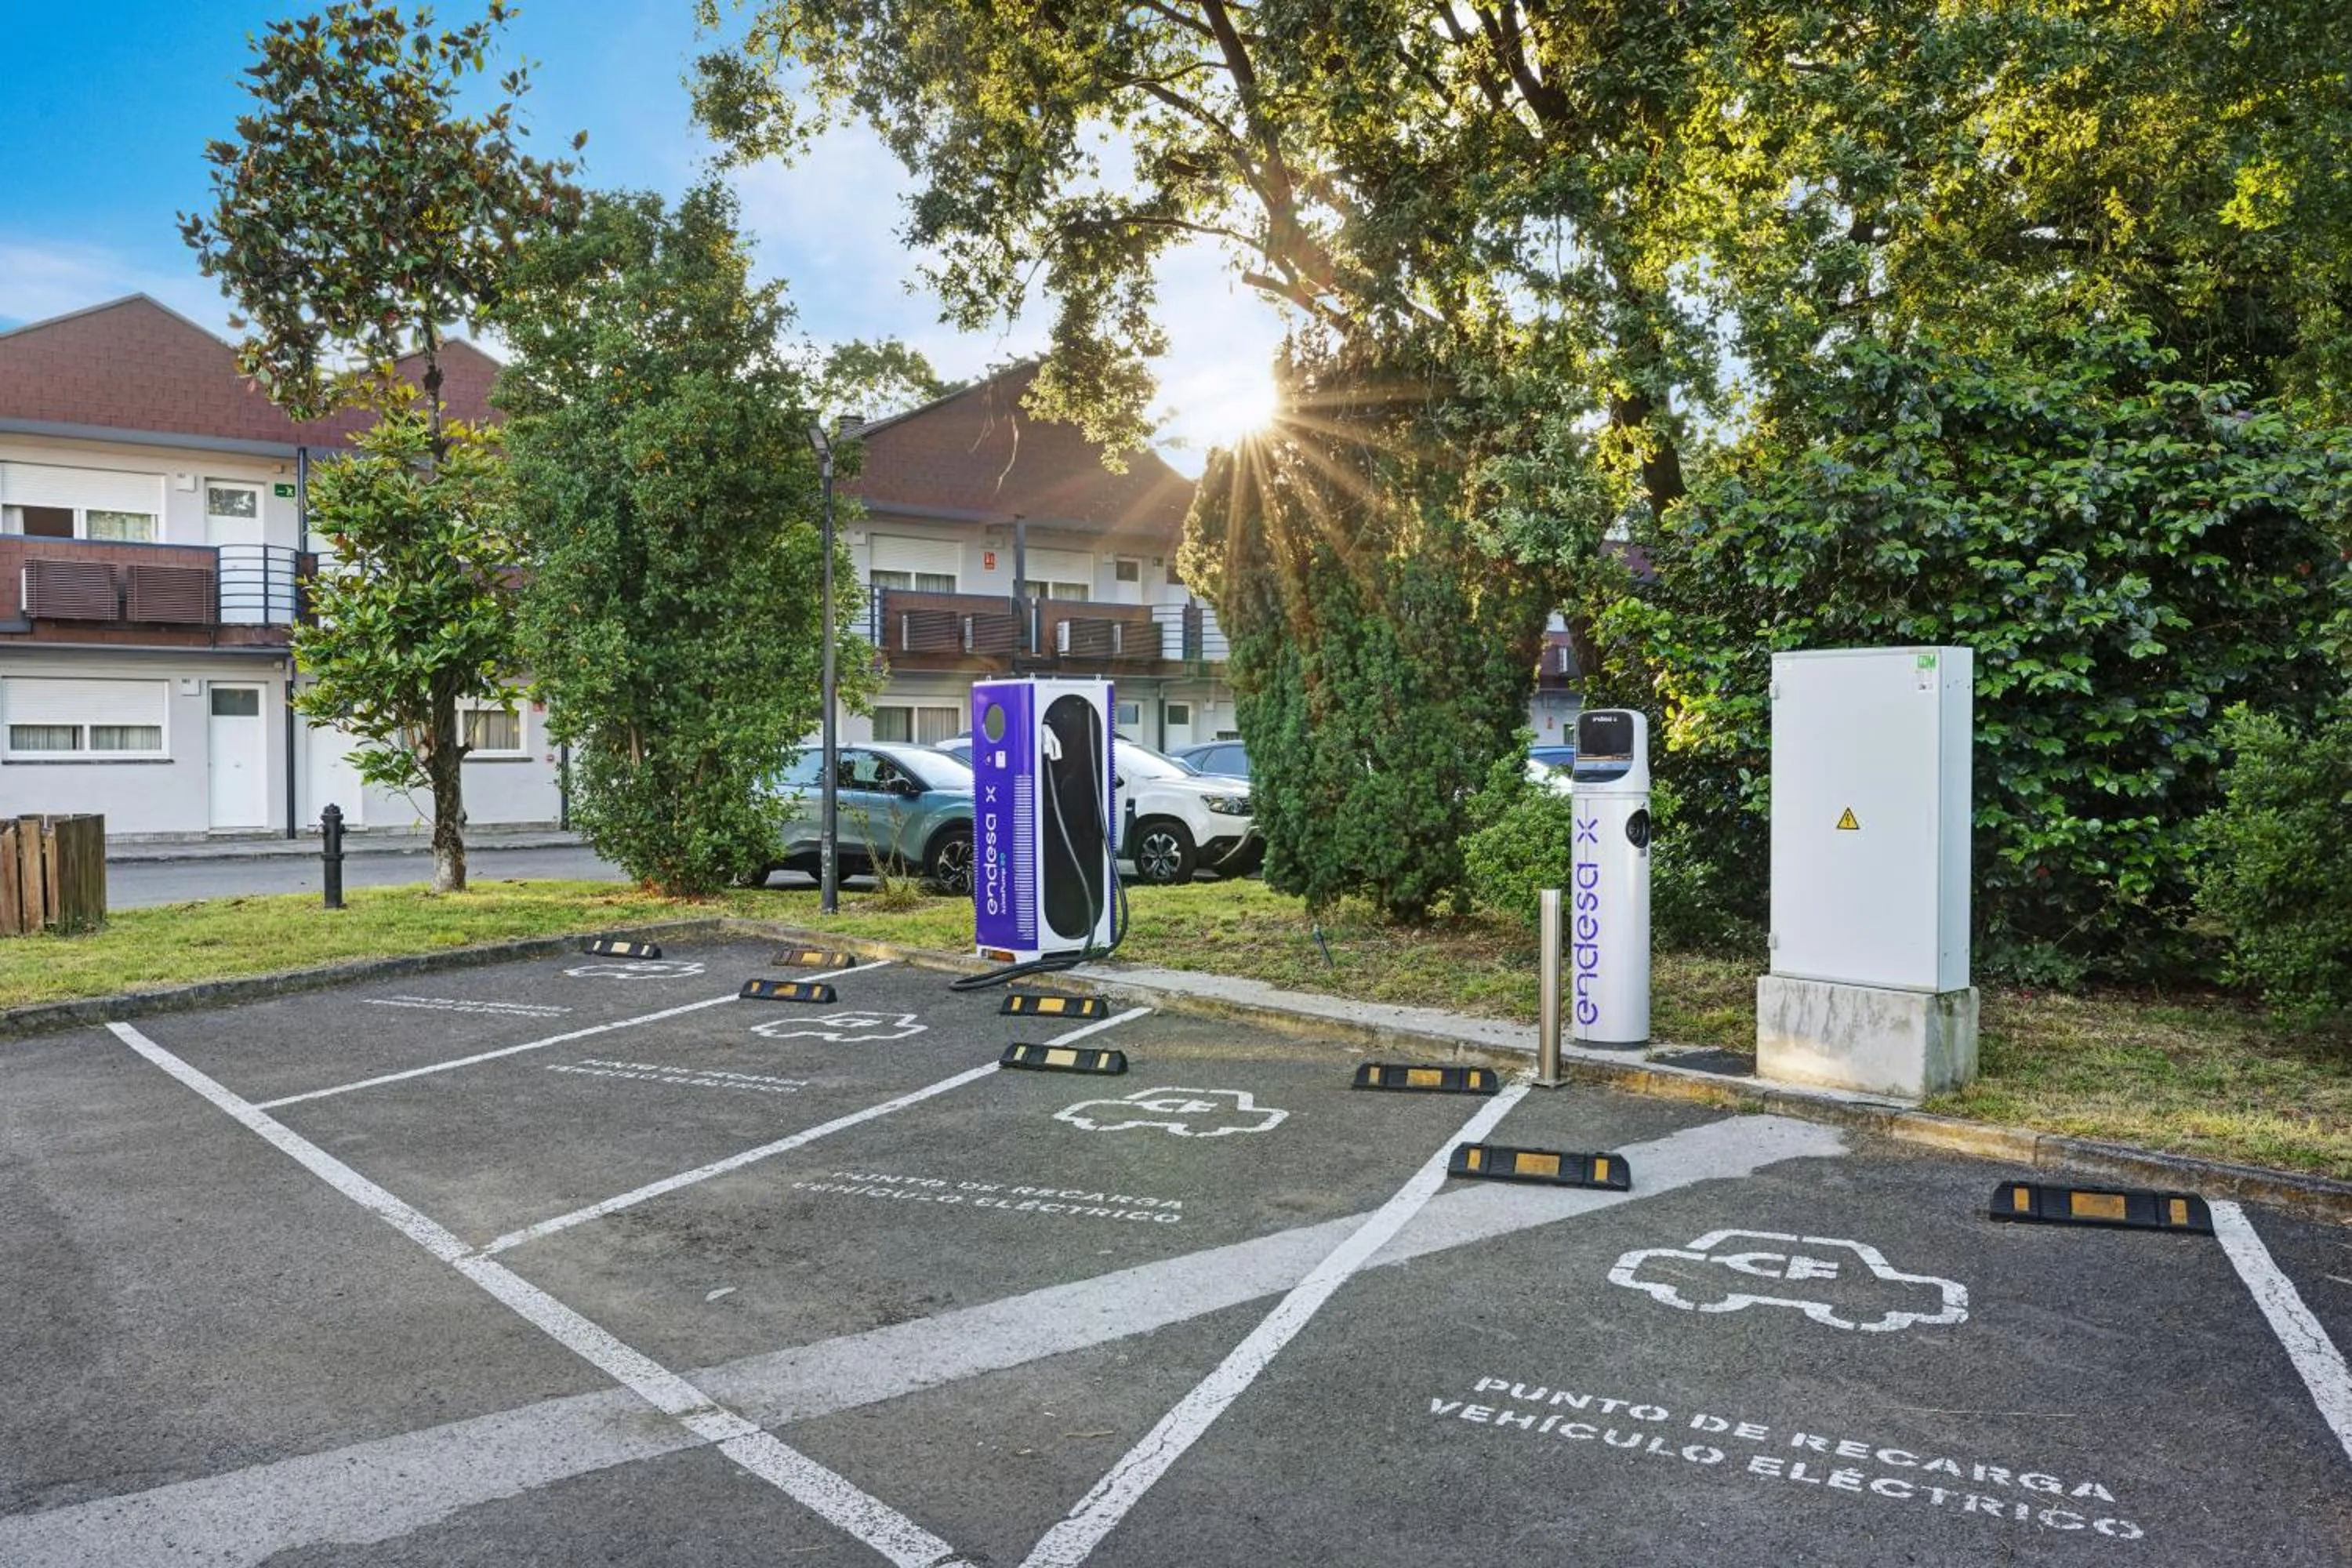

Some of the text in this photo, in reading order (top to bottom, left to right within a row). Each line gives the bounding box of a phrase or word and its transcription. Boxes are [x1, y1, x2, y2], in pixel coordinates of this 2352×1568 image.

[983, 813, 998, 915] endesa
[1573, 863, 1599, 1025] endesa
[958, 1181, 1006, 1192] DE
[1011, 1186, 1182, 1209] RECARGA
[1473, 1376, 2116, 1503] PUNTO DE RECARGA
[1747, 1455, 2144, 1540] ELÉCTRICO
